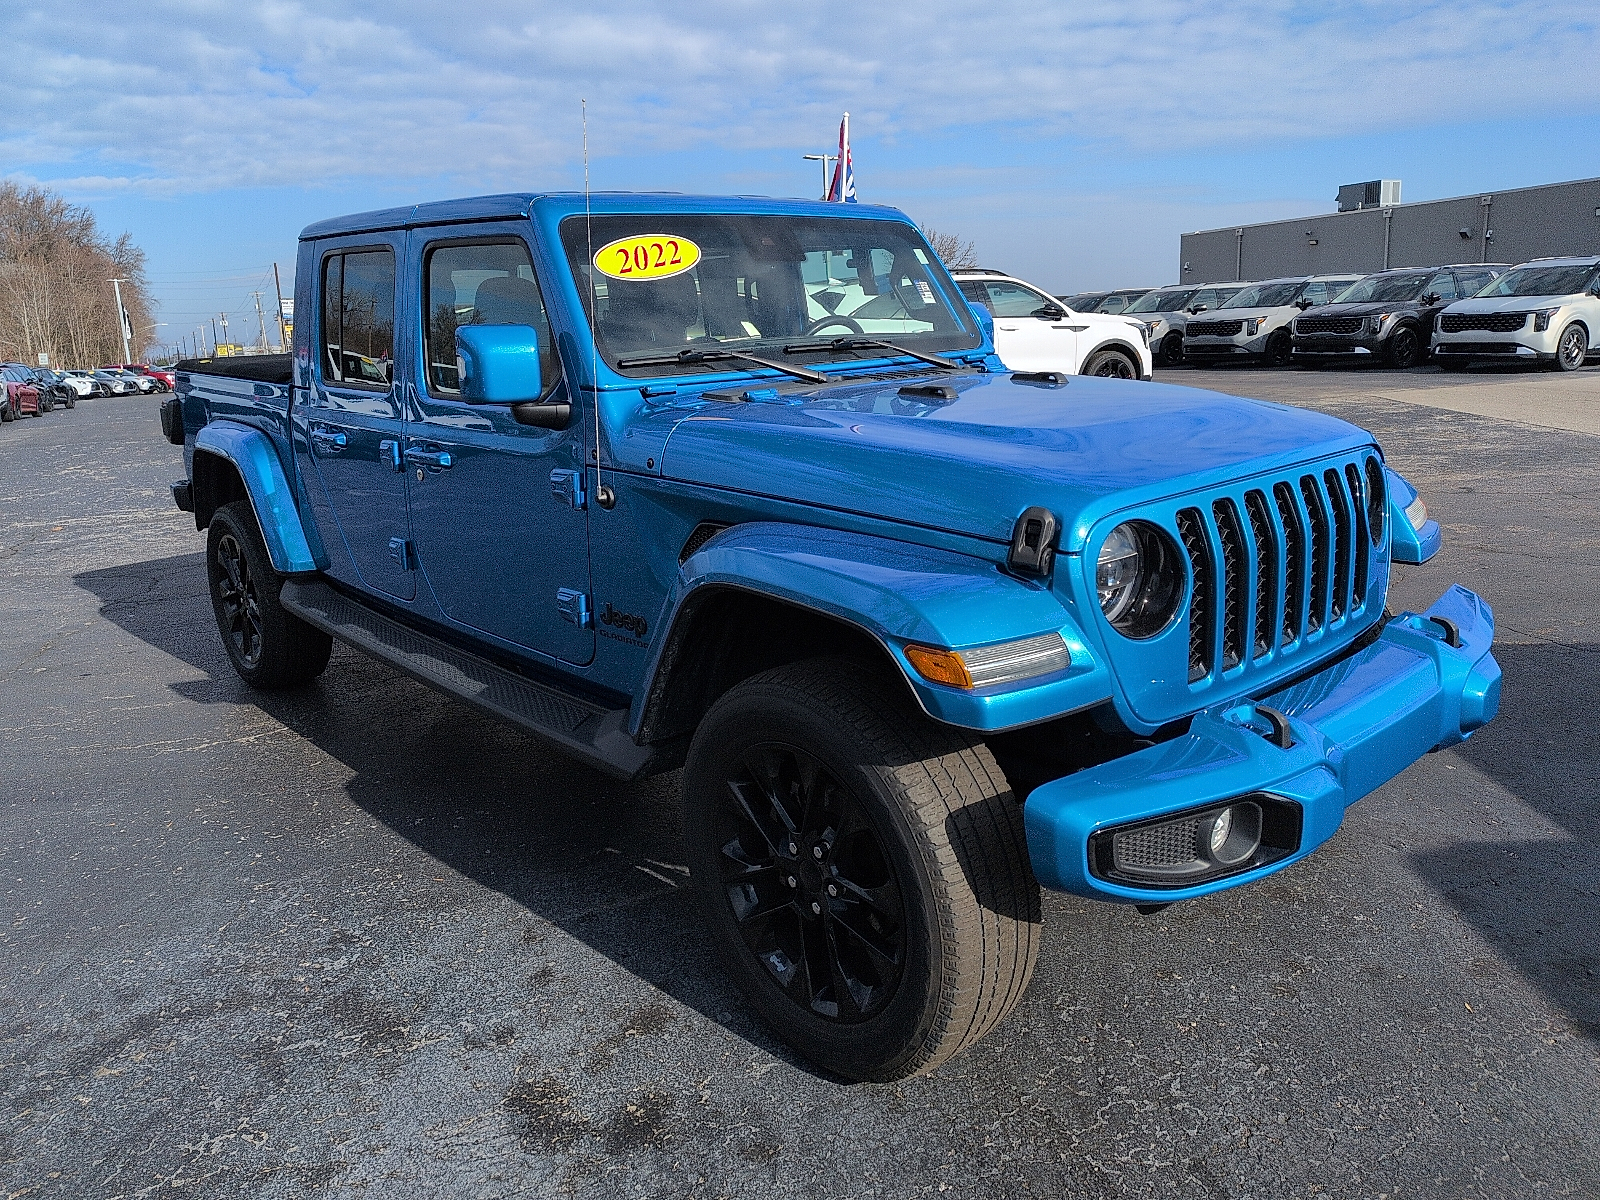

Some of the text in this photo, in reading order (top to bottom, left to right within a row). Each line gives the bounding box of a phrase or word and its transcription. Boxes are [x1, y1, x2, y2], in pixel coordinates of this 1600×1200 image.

[616, 240, 681, 274] 2022
[600, 602, 647, 638] Jeep
[600, 629, 649, 649] GLADIATOR
